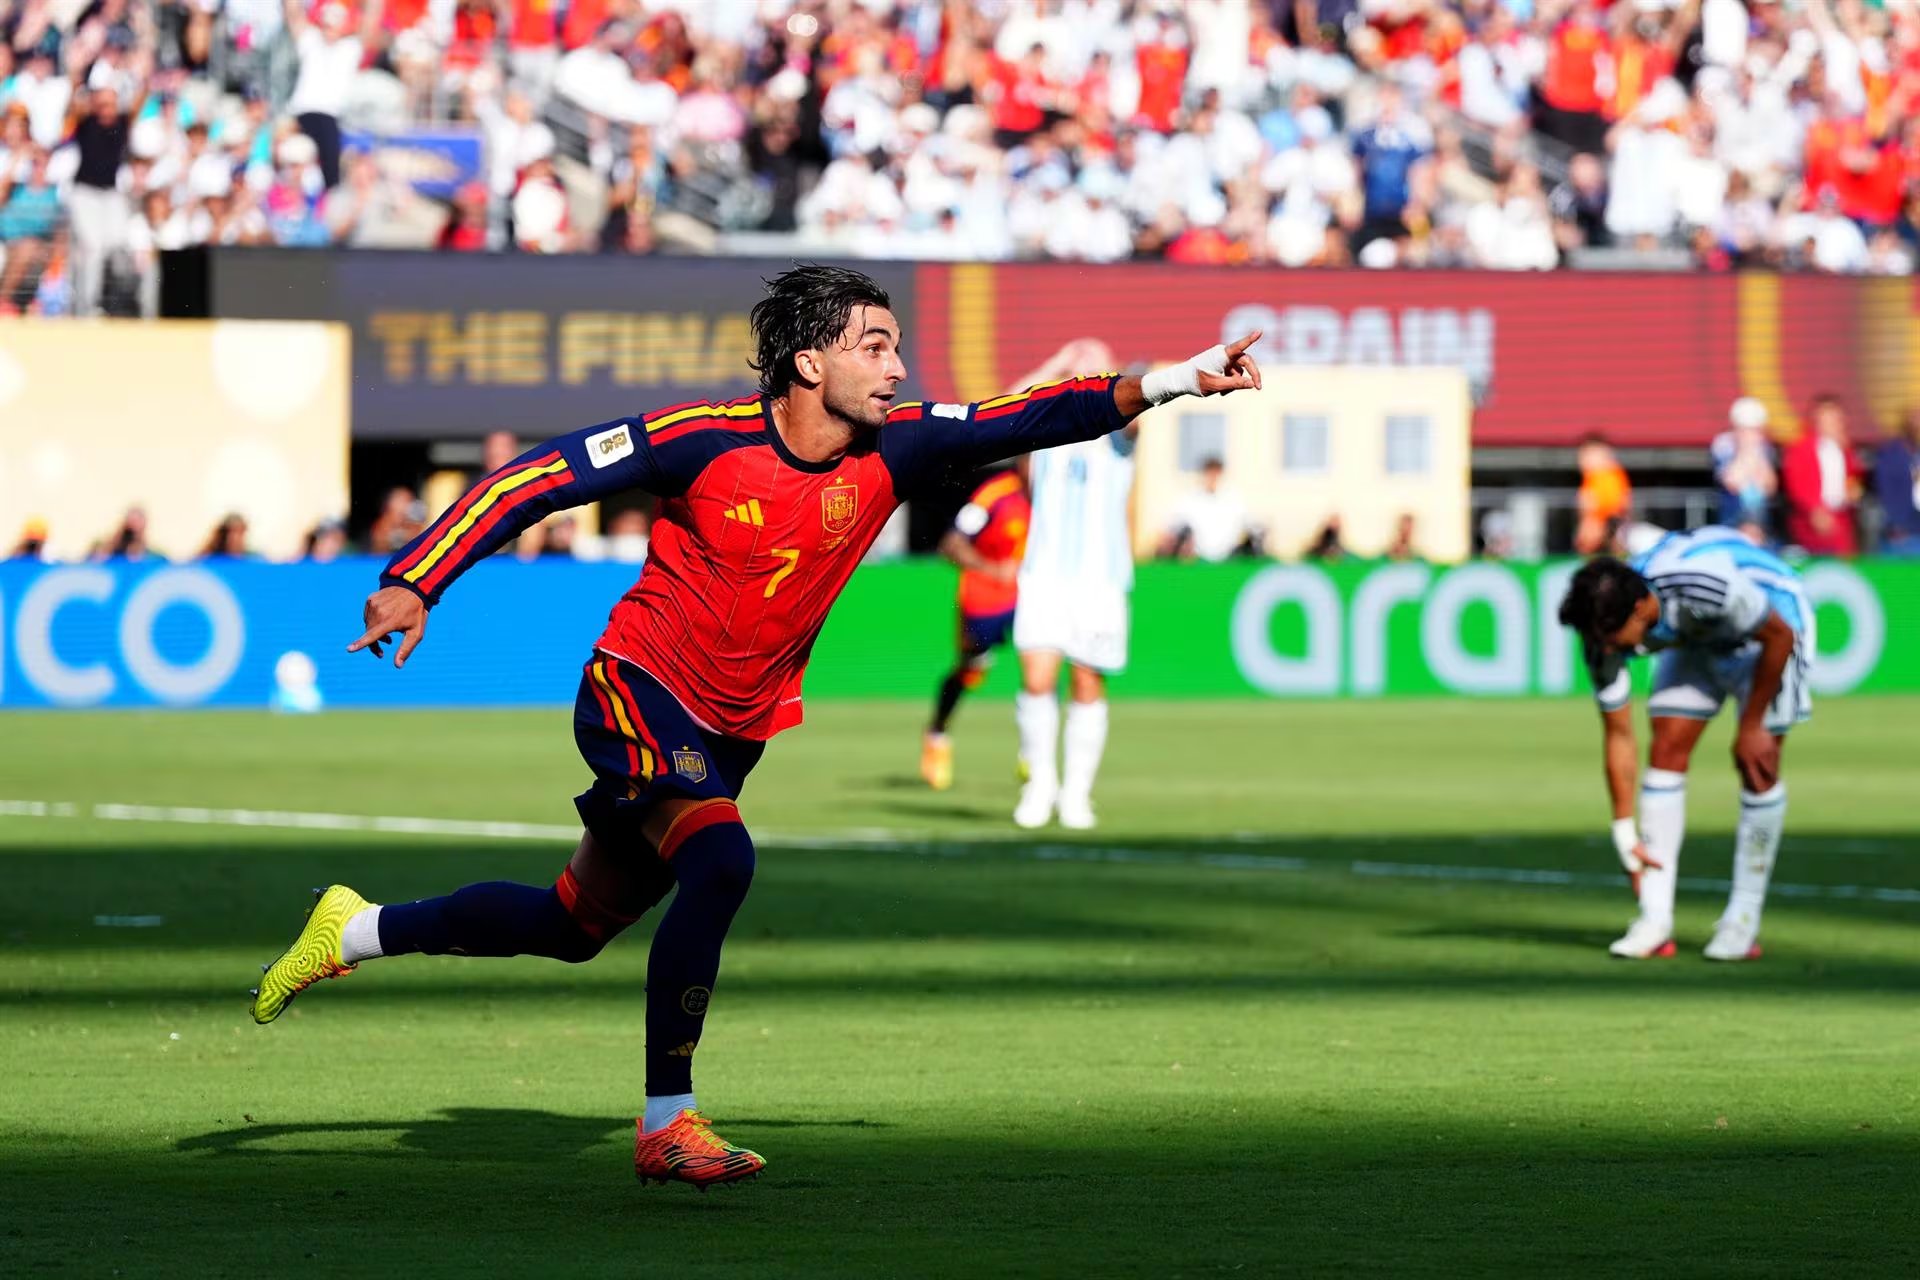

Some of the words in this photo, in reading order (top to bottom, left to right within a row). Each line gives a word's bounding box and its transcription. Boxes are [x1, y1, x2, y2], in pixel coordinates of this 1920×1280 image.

[370, 311, 548, 385] THE
[559, 312, 760, 386] FINA
[764, 549, 800, 598] 7
